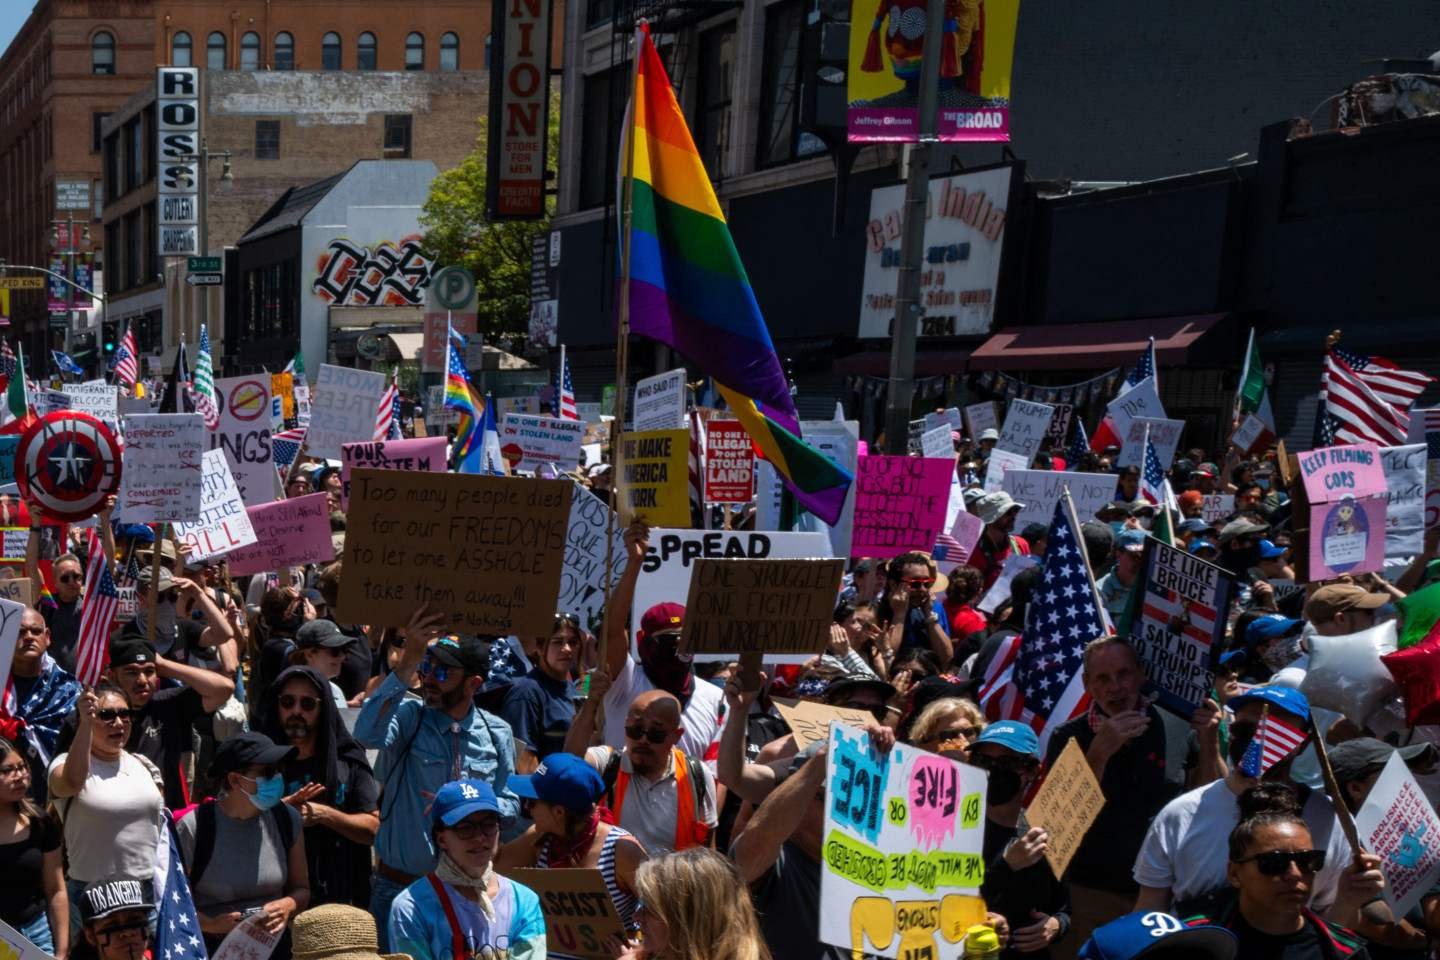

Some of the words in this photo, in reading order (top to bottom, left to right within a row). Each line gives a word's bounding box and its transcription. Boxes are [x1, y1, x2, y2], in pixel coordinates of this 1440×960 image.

[163, 71, 196, 189] ROSS
[854, 117, 883, 127] Jeffrey
[883, 116, 913, 126] Gibson
[956, 112, 1003, 129] BROAD
[505, 142, 539, 152] STORE
[511, 153, 530, 163] FOR
[510, 164, 533, 174] MEN
[163, 198, 194, 221] CUTLERY
[939, 178, 1007, 242] India
[22, 279, 41, 287] XING
[63, 384, 116, 396] IMMIGRANTS
[637, 384, 652, 400] WHO
[652, 380, 669, 396] SAID
[1013, 403, 1051, 417] TRUMP
[126, 430, 175, 438] DEPORTED
[507, 417, 520, 427] NO
[522, 418, 539, 428] ONE
[550, 421, 582, 433] ILLEGAL
[520, 429, 550, 441] STOLEN
[551, 432, 574, 443] LAND
[710, 430, 723, 440] NO
[724, 430, 742, 440] ONE
[178, 450, 195, 459] ICE
[638, 436, 673, 458] MAKE
[708, 437, 753, 451] ILLEGAL
[708, 457, 752, 470] STOLEN
[1300, 453, 1328, 477] KEEP
[1329, 449, 1374, 466] FILMING
[709, 469, 751, 484] LAND
[1324, 471, 1356, 490] COPS
[127, 488, 182, 498] CONDEMNED
[361, 477, 396, 503] Too
[407, 486, 449, 513] many
[456, 485, 516, 512] people
[527, 484, 565, 509] died
[185, 520, 241, 557] ALL
[371, 514, 401, 536] for
[406, 519, 442, 539] our
[448, 514, 564, 550] FREEDOMS
[413, 552, 447, 570] one
[452, 550, 545, 576] ASSHOLE
[642, 532, 772, 574] SPREAD
[698, 560, 737, 589] ONE
[1159, 545, 1179, 570] BE
[1181, 555, 1215, 586] LIKE
[363, 579, 404, 601] take
[414, 578, 456, 603] them
[463, 583, 526, 610] away!!!
[1156, 568, 1211, 606] BRUCE.
[695, 590, 735, 616] ONE
[1145, 623, 1174, 649] SAY
[1176, 636, 1198, 663] NO
[1130, 633, 1148, 658] TO
[1151, 643, 1216, 691] TRUMP'S
[834, 754, 881, 831] ICE
[889, 800, 907, 821] OR
[963, 798, 980, 823] BY
[1369, 801, 1400, 846] ABOLISH
[826, 840, 888, 888] CRUSHED
[891, 857, 906, 881] BE
[909, 861, 938, 890] NOT
[939, 858, 962, 877] WILL
[965, 857, 982, 880] WE
[86, 885, 108, 914] LOS
[106, 880, 143, 907] ANGELES
[897, 906, 939, 931] STRONG
